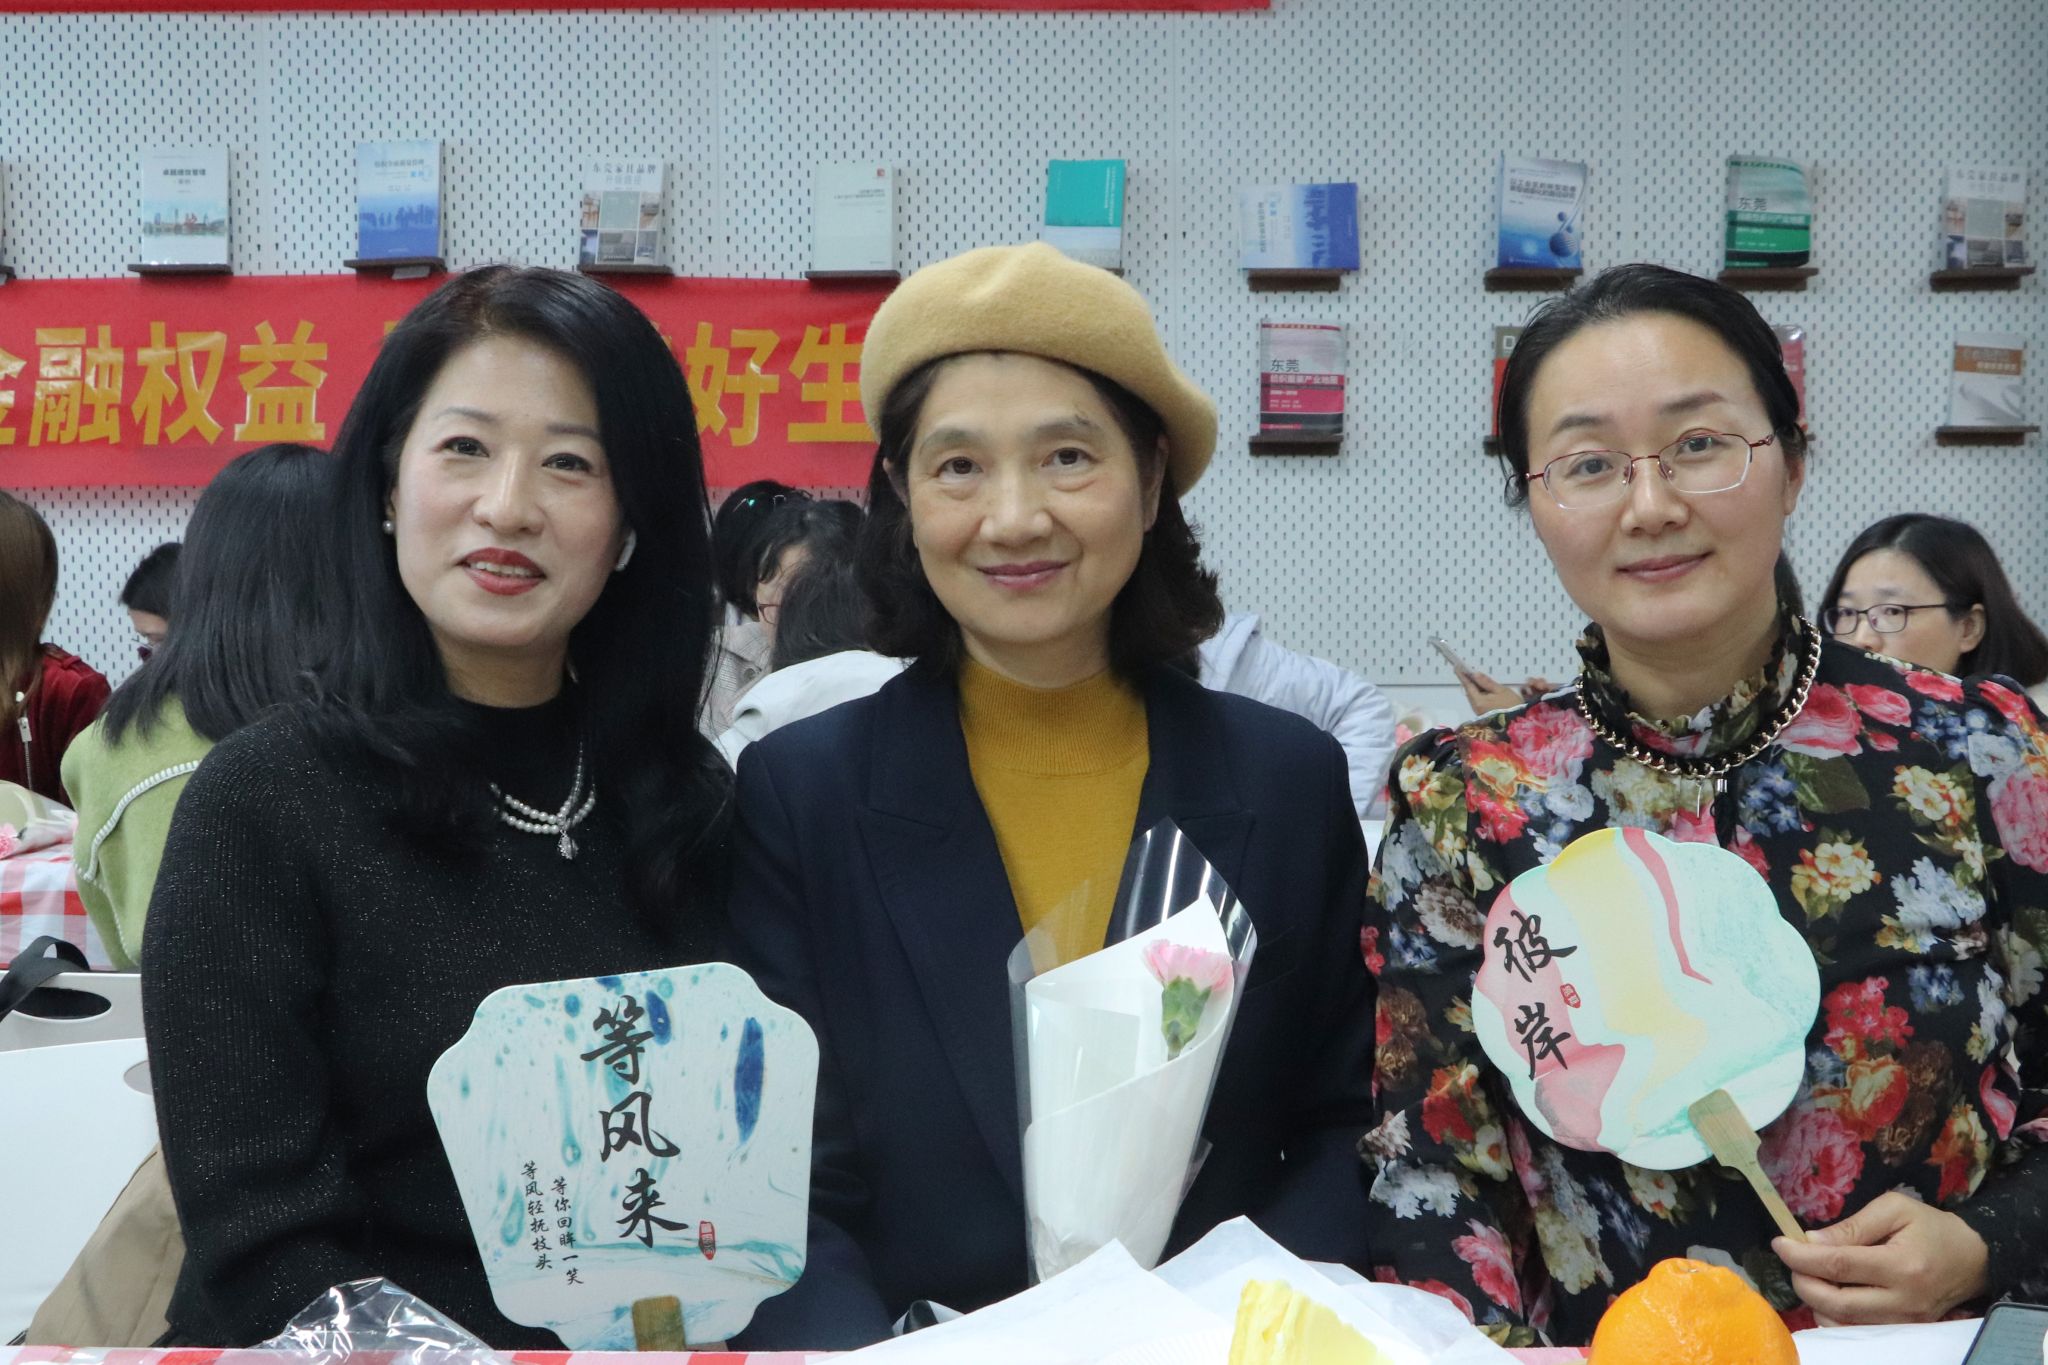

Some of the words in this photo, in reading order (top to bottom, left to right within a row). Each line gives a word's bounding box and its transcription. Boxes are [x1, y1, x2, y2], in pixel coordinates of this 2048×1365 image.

[1737, 197, 1768, 211] 东莞
[0, 320, 328, 448] 融权益
[1270, 359, 1300, 373] 东莞
[1493, 909, 1578, 1081] 彼岸
[580, 994, 689, 1249] 等风来
[521, 1160, 553, 1271] 等风轻抚枝头
[550, 1177, 585, 1286] 等你回眸一笑
